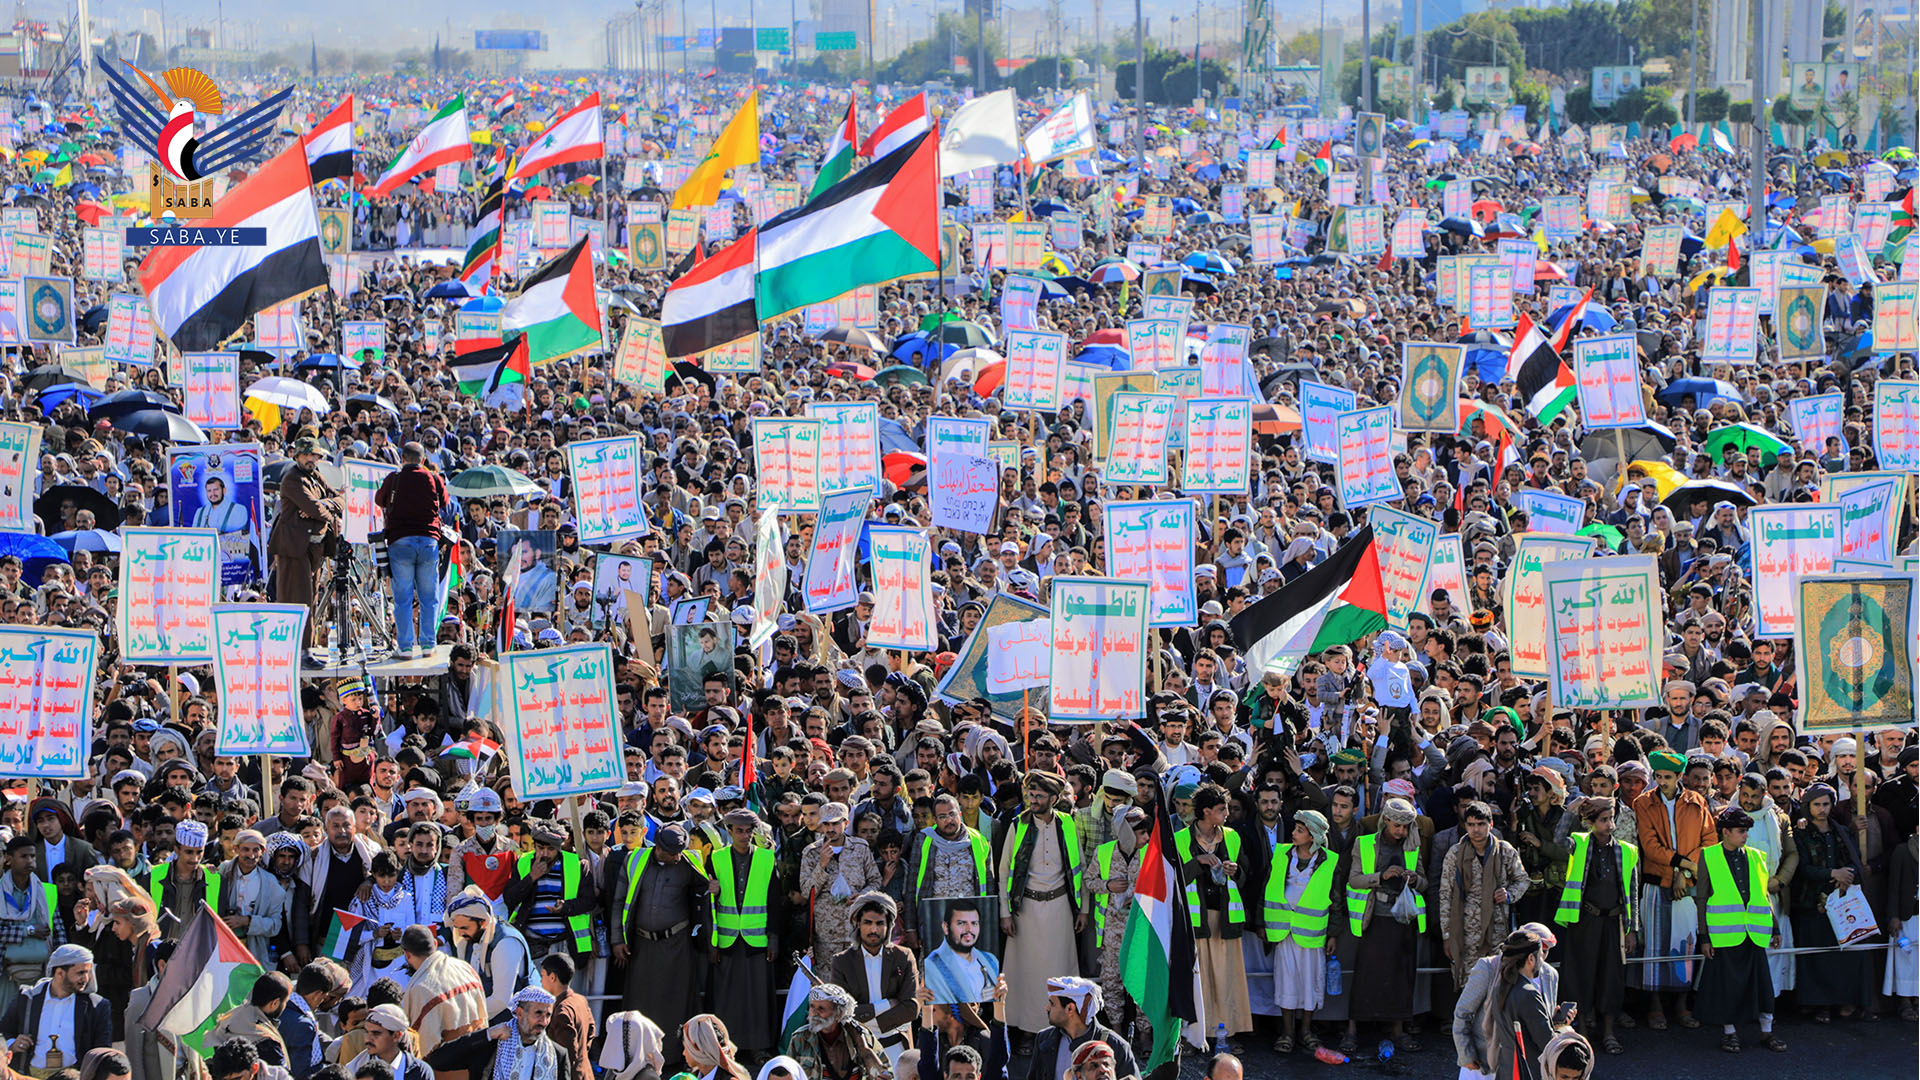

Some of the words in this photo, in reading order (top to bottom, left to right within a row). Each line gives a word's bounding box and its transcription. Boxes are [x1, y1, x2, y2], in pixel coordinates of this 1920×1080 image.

[1041, 339, 1059, 351] الله
[1582, 341, 1630, 367] قاطعوا
[188, 358, 231, 377] قاطعوا
[209, 395, 213, 407] و
[1608, 388, 1613, 401] و
[851, 408, 875, 424] الله
[1119, 398, 1152, 416] أكبر
[1152, 401, 1172, 414] الله
[1191, 403, 1223, 425] أكبر
[1224, 406, 1245, 420] الله
[1341, 415, 1368, 438] أكبر
[1370, 414, 1387, 428] الله
[760, 424, 795, 444] أكبر
[795, 428, 818, 443] الله
[935, 424, 982, 446] قاطعوا
[577, 446, 609, 470] أكبر
[611, 446, 634, 461] الله
[610, 464, 635, 481] الموت
[1138, 462, 1163, 478] النصر
[1216, 472, 1242, 487] النصر
[612, 480, 636, 496] الموت
[1374, 476, 1392, 496] النصر
[619, 497, 637, 511] اللعنة
[792, 487, 818, 507] النصر
[821, 498, 867, 529] قاطعوا
[1528, 498, 1576, 524] قاطعوا
[1843, 489, 1885, 528] قاطعوا
[616, 511, 640, 532] النصر
[1113, 508, 1158, 538] أكبر
[1158, 509, 1187, 529] الله
[1407, 526, 1430, 545] الله
[1760, 514, 1834, 547] قاطعوا
[132, 538, 181, 567] أكبر
[183, 542, 211, 562] الله
[873, 540, 922, 563] قاطعوا
[1114, 536, 1152, 556] لأمريكا
[1153, 537, 1186, 552] الموت
[1398, 545, 1425, 564] الموت
[1758, 547, 1799, 578] الأمريكية
[833, 557, 839, 572] و
[1154, 560, 1186, 575] الموت
[1392, 564, 1421, 582] الموت
[130, 568, 173, 586] لأمريكا
[177, 569, 211, 586] الموت
[1163, 580, 1186, 592] اللعنة
[131, 592, 173, 608] لإسرائيل
[176, 592, 210, 608] الموت
[1394, 586, 1415, 602] اللعنة
[1556, 581, 1607, 616] أكبر
[1610, 582, 1643, 604] الله
[895, 595, 900, 611] و
[1060, 588, 1137, 622] قاطعوا
[1155, 595, 1190, 620] النصر
[130, 615, 160, 630] اليهود
[164, 615, 182, 630] على
[185, 615, 210, 628] اللعنة
[268, 620, 296, 641] الله
[871, 616, 924, 639] الإسرائيلية
[1558, 613, 1602, 636] لأمريكا
[1606, 612, 1644, 632] الموت
[222, 617, 268, 648] أكبر
[1054, 625, 1098, 657] الأمريكية
[53, 641, 88, 664] الله
[131, 633, 171, 655] للإسلام
[176, 633, 212, 655] النصر
[1101, 631, 1139, 657] البضائع
[1560, 640, 1604, 661] لإسرائيل
[1608, 637, 1645, 656] الموت
[224, 650, 263, 669] لأمريكا
[266, 652, 292, 668] الموت
[571, 657, 606, 681] الله
[1091, 658, 1098, 680] و
[1620, 659, 1650, 676] اللعنة
[518, 657, 570, 693] أكبر
[1562, 665, 1594, 684] اليهود
[1598, 664, 1615, 682] على
[45, 675, 84, 692] الموت
[228, 676, 262, 694] لإسرائيل
[265, 675, 292, 693] الموت
[1616, 680, 1655, 705] النصر
[43, 700, 81, 716] الموت
[519, 692, 567, 713] لأمريكا
[569, 689, 608, 708] الموت
[1053, 687, 1139, 715] الإسرائيلية
[228, 700, 253, 718] اليهود
[256, 703, 270, 719] على
[272, 701, 294, 717] اللعنة
[26, 719, 46, 740] على
[49, 719, 79, 738] اللعنة
[523, 717, 570, 740] لإسرائيل
[572, 713, 610, 732] الموت
[225, 723, 264, 750] للإسلام
[267, 722, 300, 748] النصر
[524, 741, 558, 763] اليهود
[562, 741, 580, 759] على
[584, 737, 612, 755] اللعنة
[36, 744, 79, 769] النصر
[528, 763, 572, 790] للإسلام
[577, 758, 617, 786] النصر
